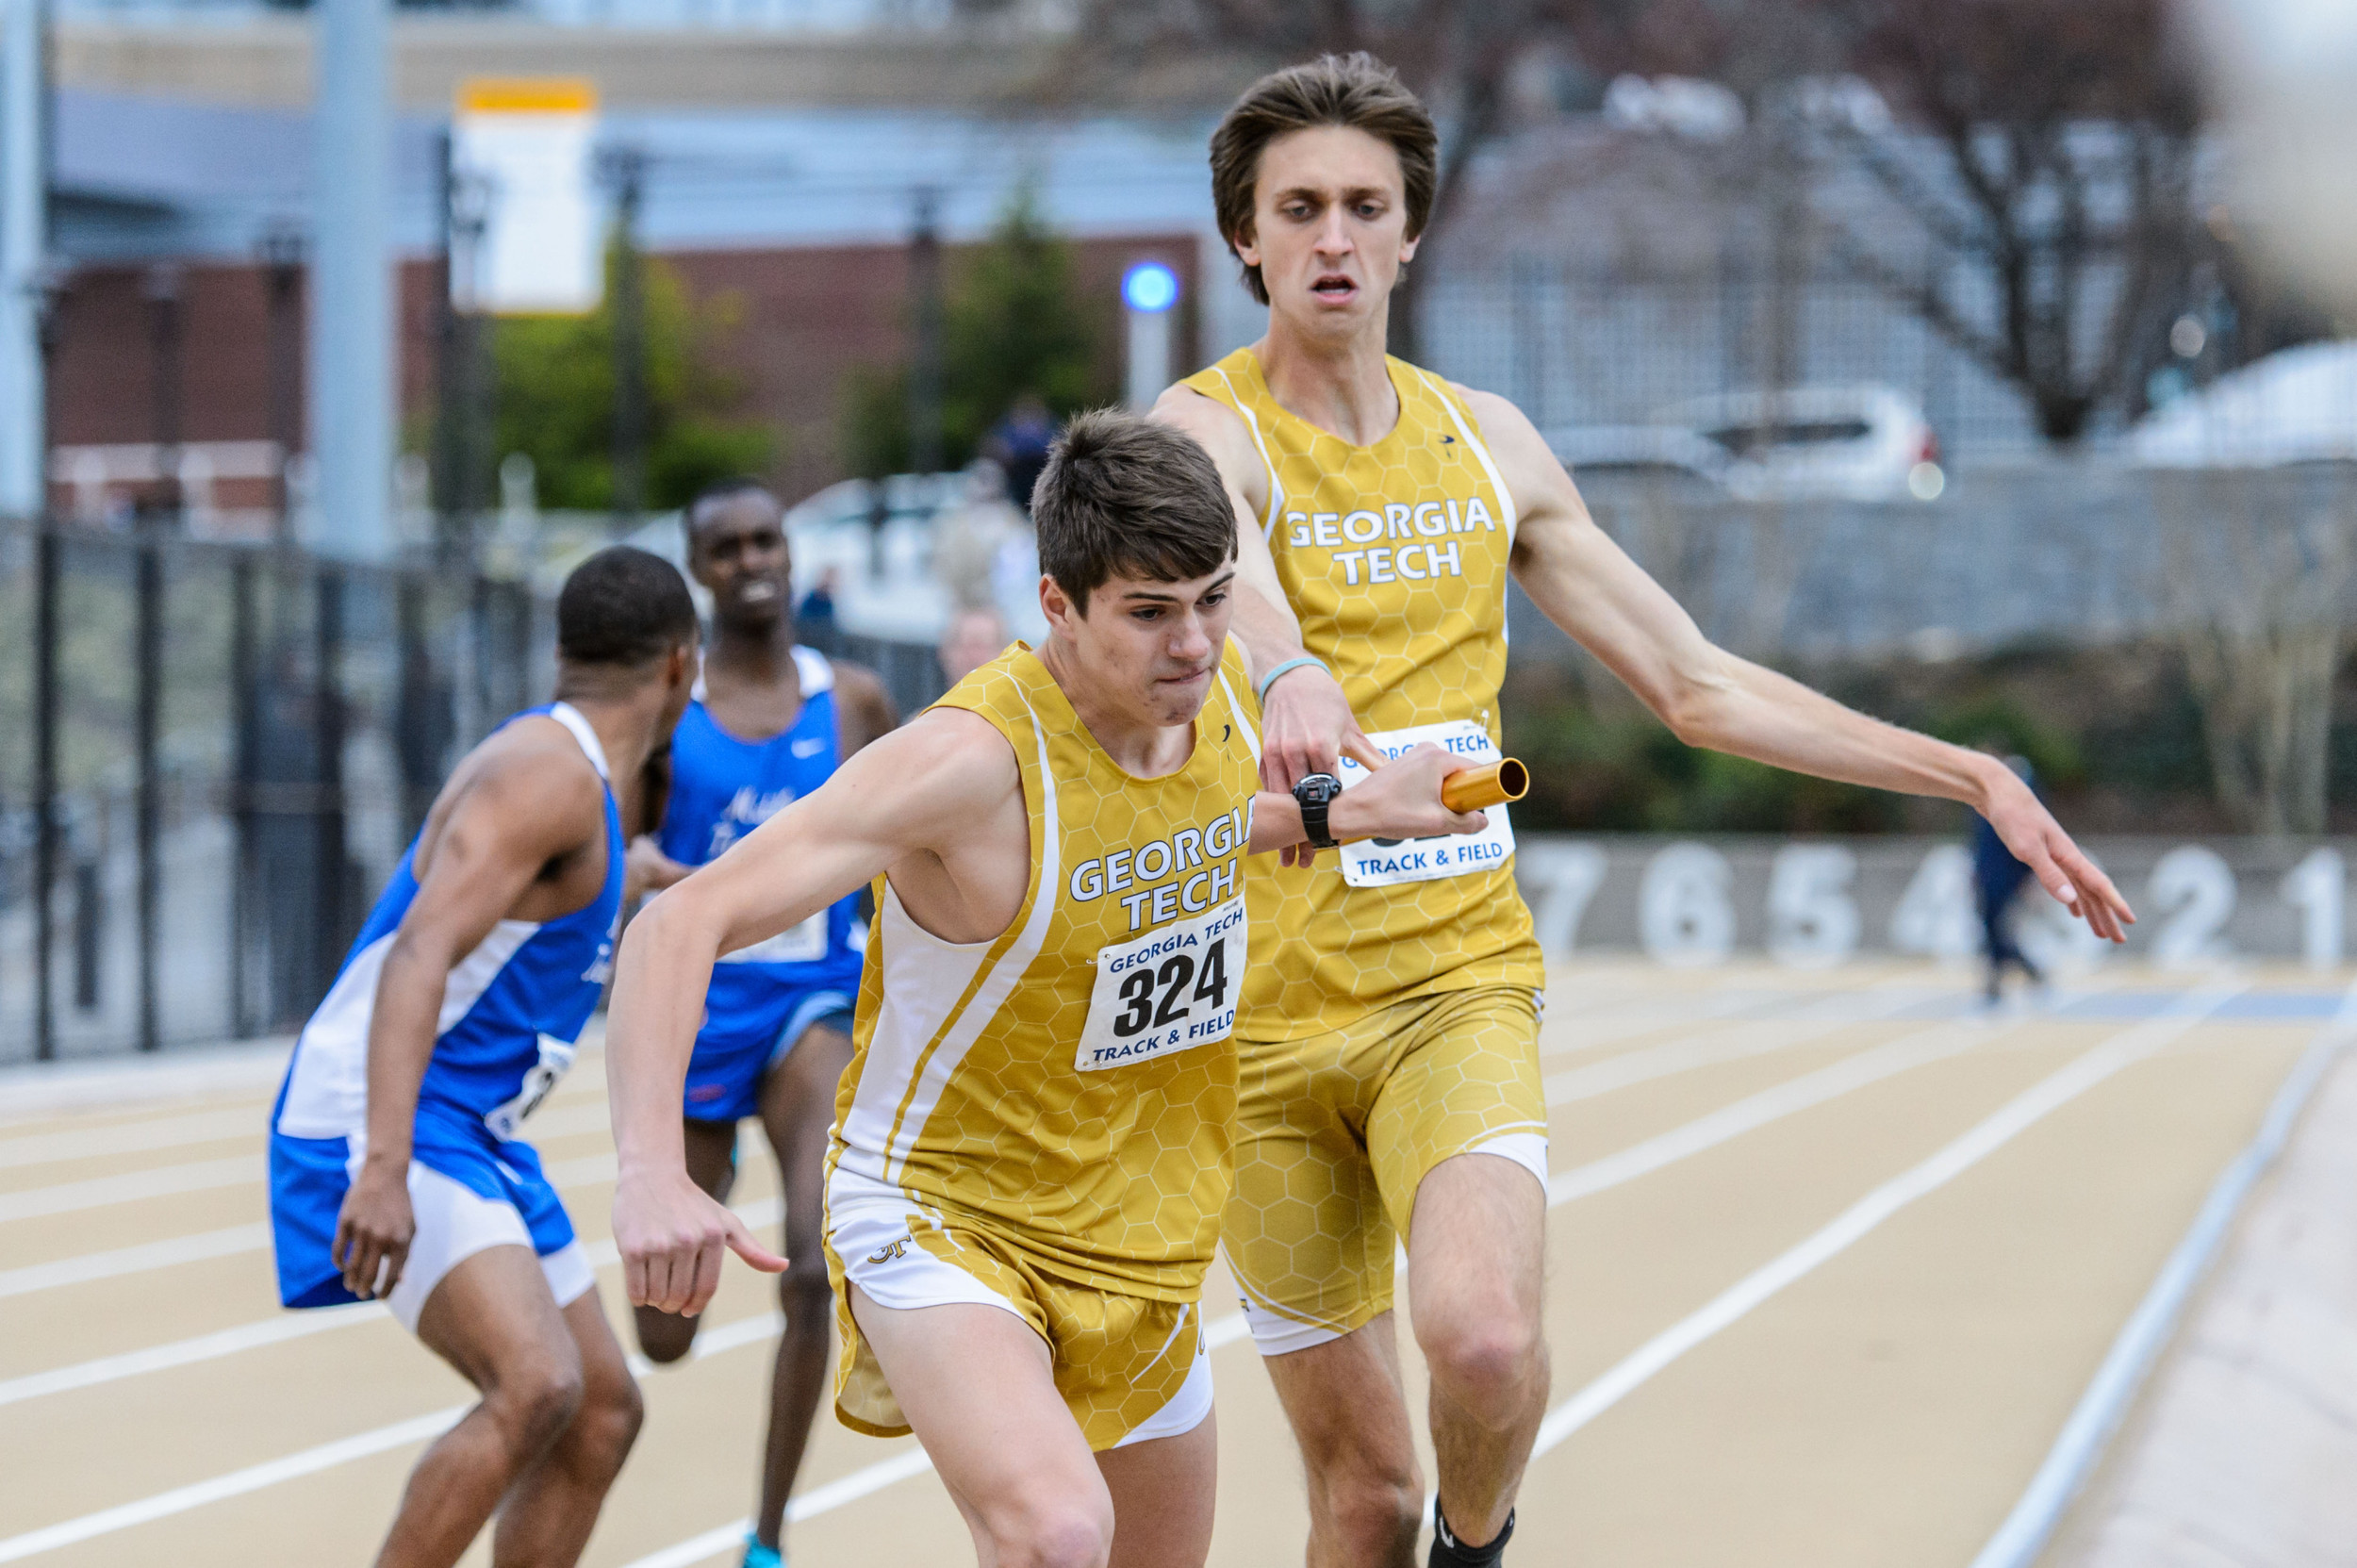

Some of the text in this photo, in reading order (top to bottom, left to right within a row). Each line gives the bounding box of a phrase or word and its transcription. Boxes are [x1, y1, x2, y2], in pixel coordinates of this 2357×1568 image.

[1286, 497, 1495, 547] GEORGIA
[1332, 540, 1461, 586] TECH
[1445, 734, 1490, 754] TECH
[1357, 852, 1427, 877] TRACK
[1436, 850, 1450, 867] &
[1459, 842, 1503, 863] FIELD
[1120, 858, 1237, 932] TECH
[1515, 842, 1608, 962] 7
[1640, 842, 1737, 966] 6
[1768, 843, 1862, 967] 5
[2148, 845, 2237, 966] 2
[2280, 847, 2346, 968] 1
[1110, 907, 1243, 973] GEORGIA TECH
[1113, 937, 1228, 1037] 324
[1093, 1035, 1160, 1062] TRACK
[1167, 1029, 1179, 1046] &
[1189, 1009, 1234, 1038] FIELD
